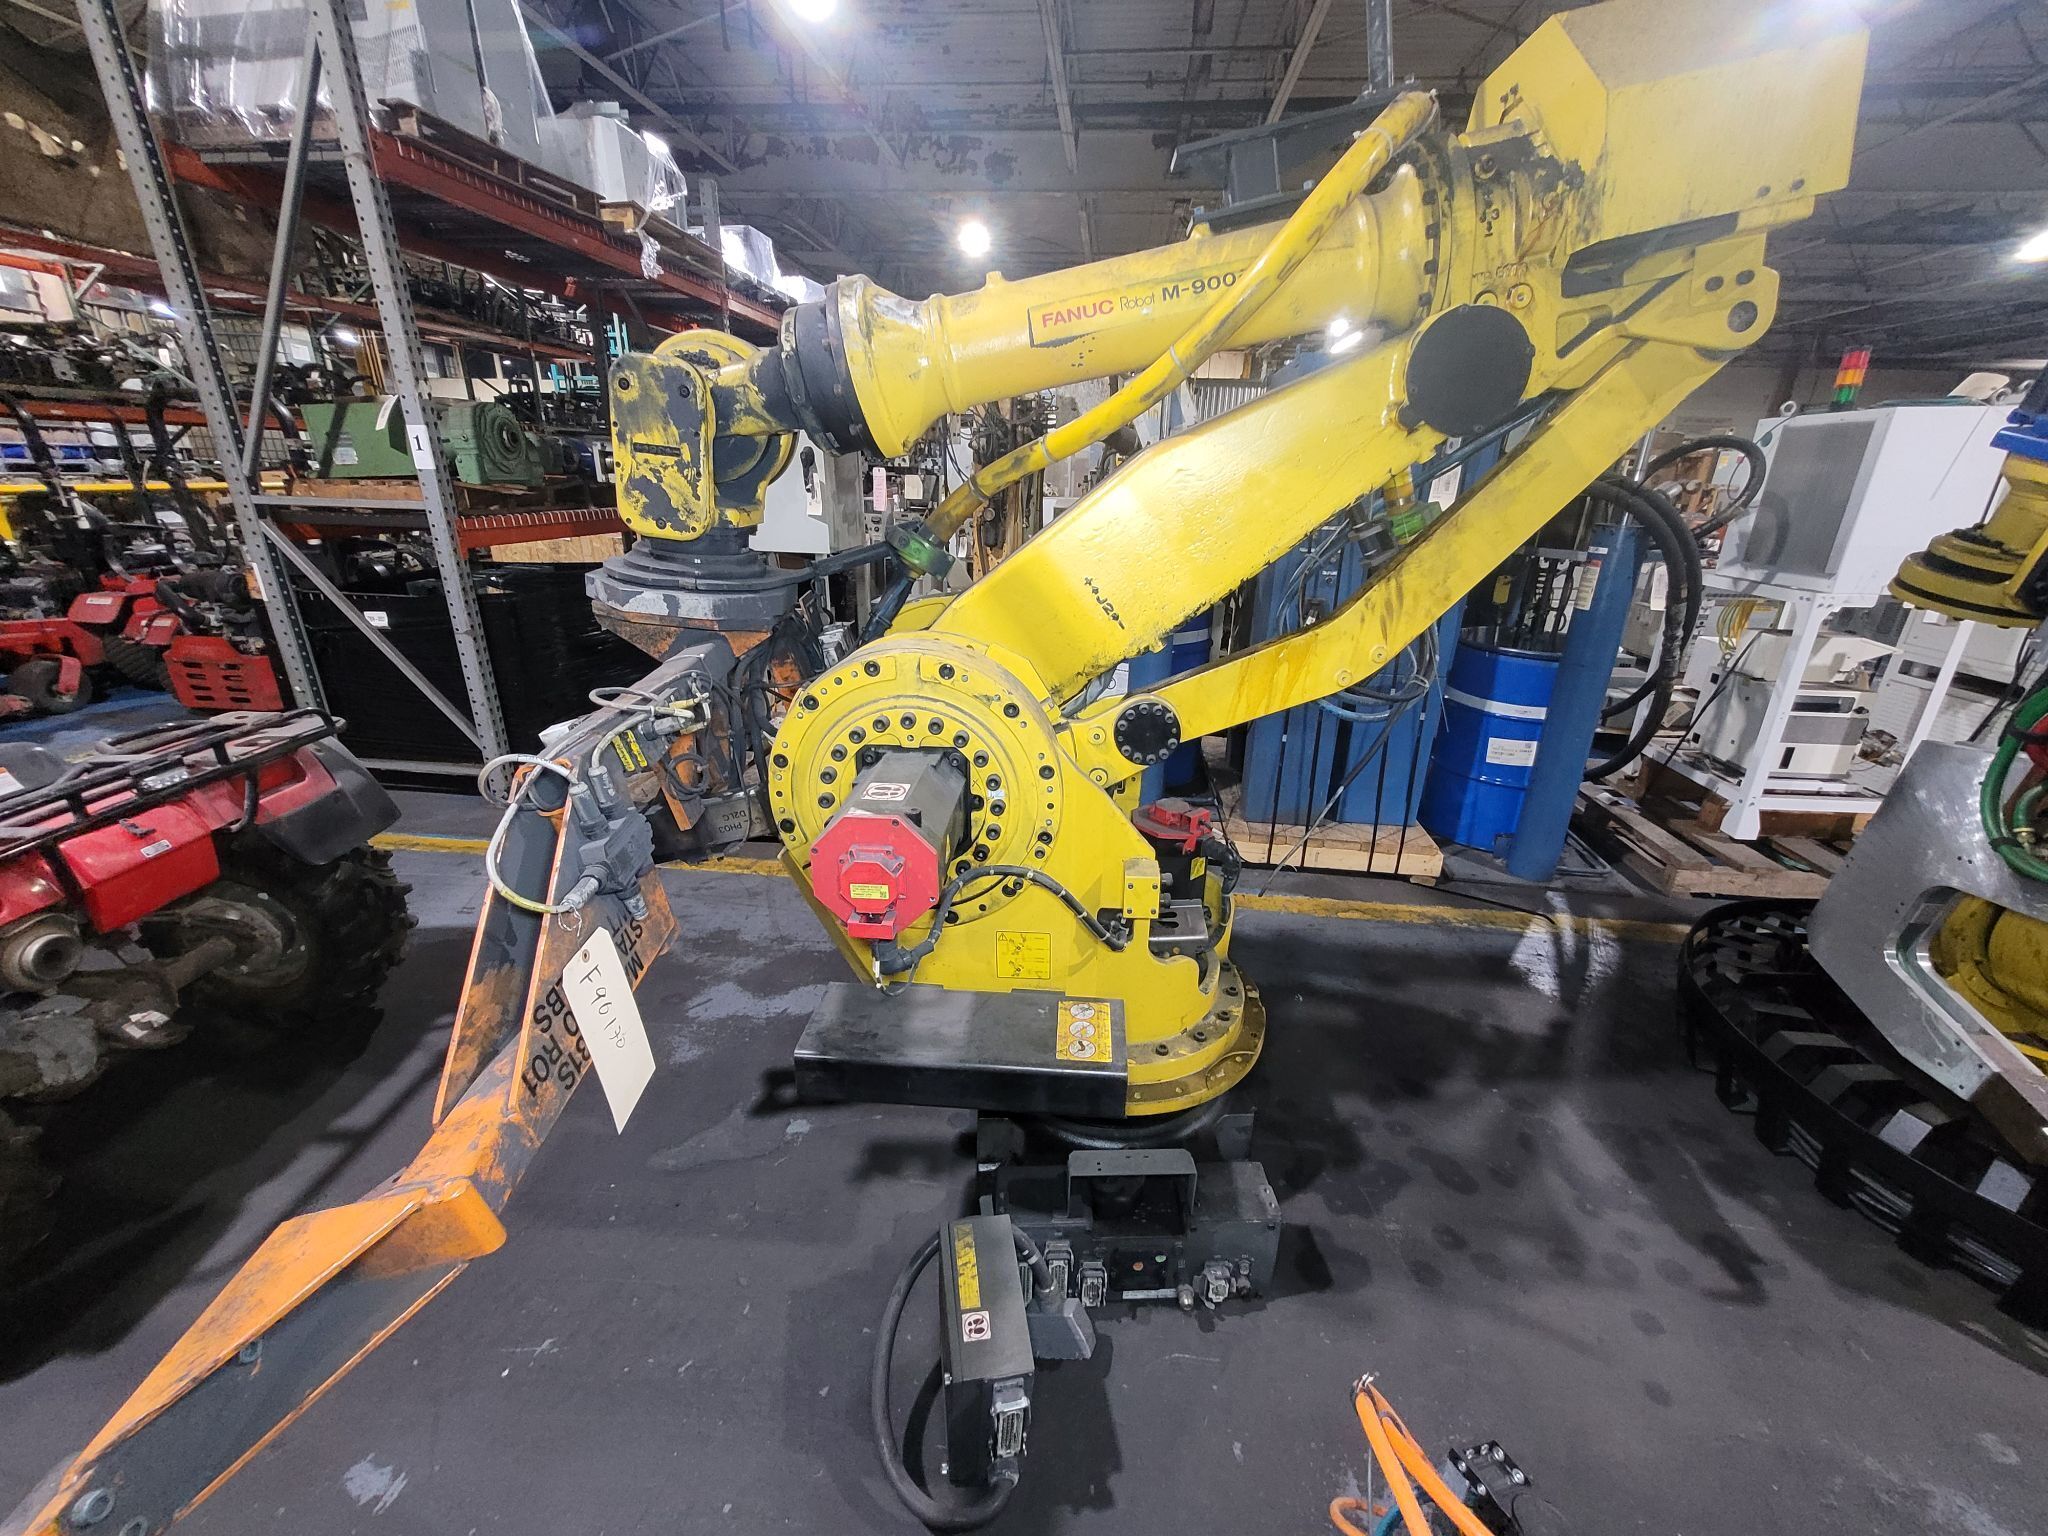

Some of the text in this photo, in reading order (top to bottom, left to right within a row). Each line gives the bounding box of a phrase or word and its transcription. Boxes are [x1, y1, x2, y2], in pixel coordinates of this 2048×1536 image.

[1042, 300, 1114, 328] FANUC
[1119, 292, 1156, 312] Robot
[413, 434, 425, 452] 1
